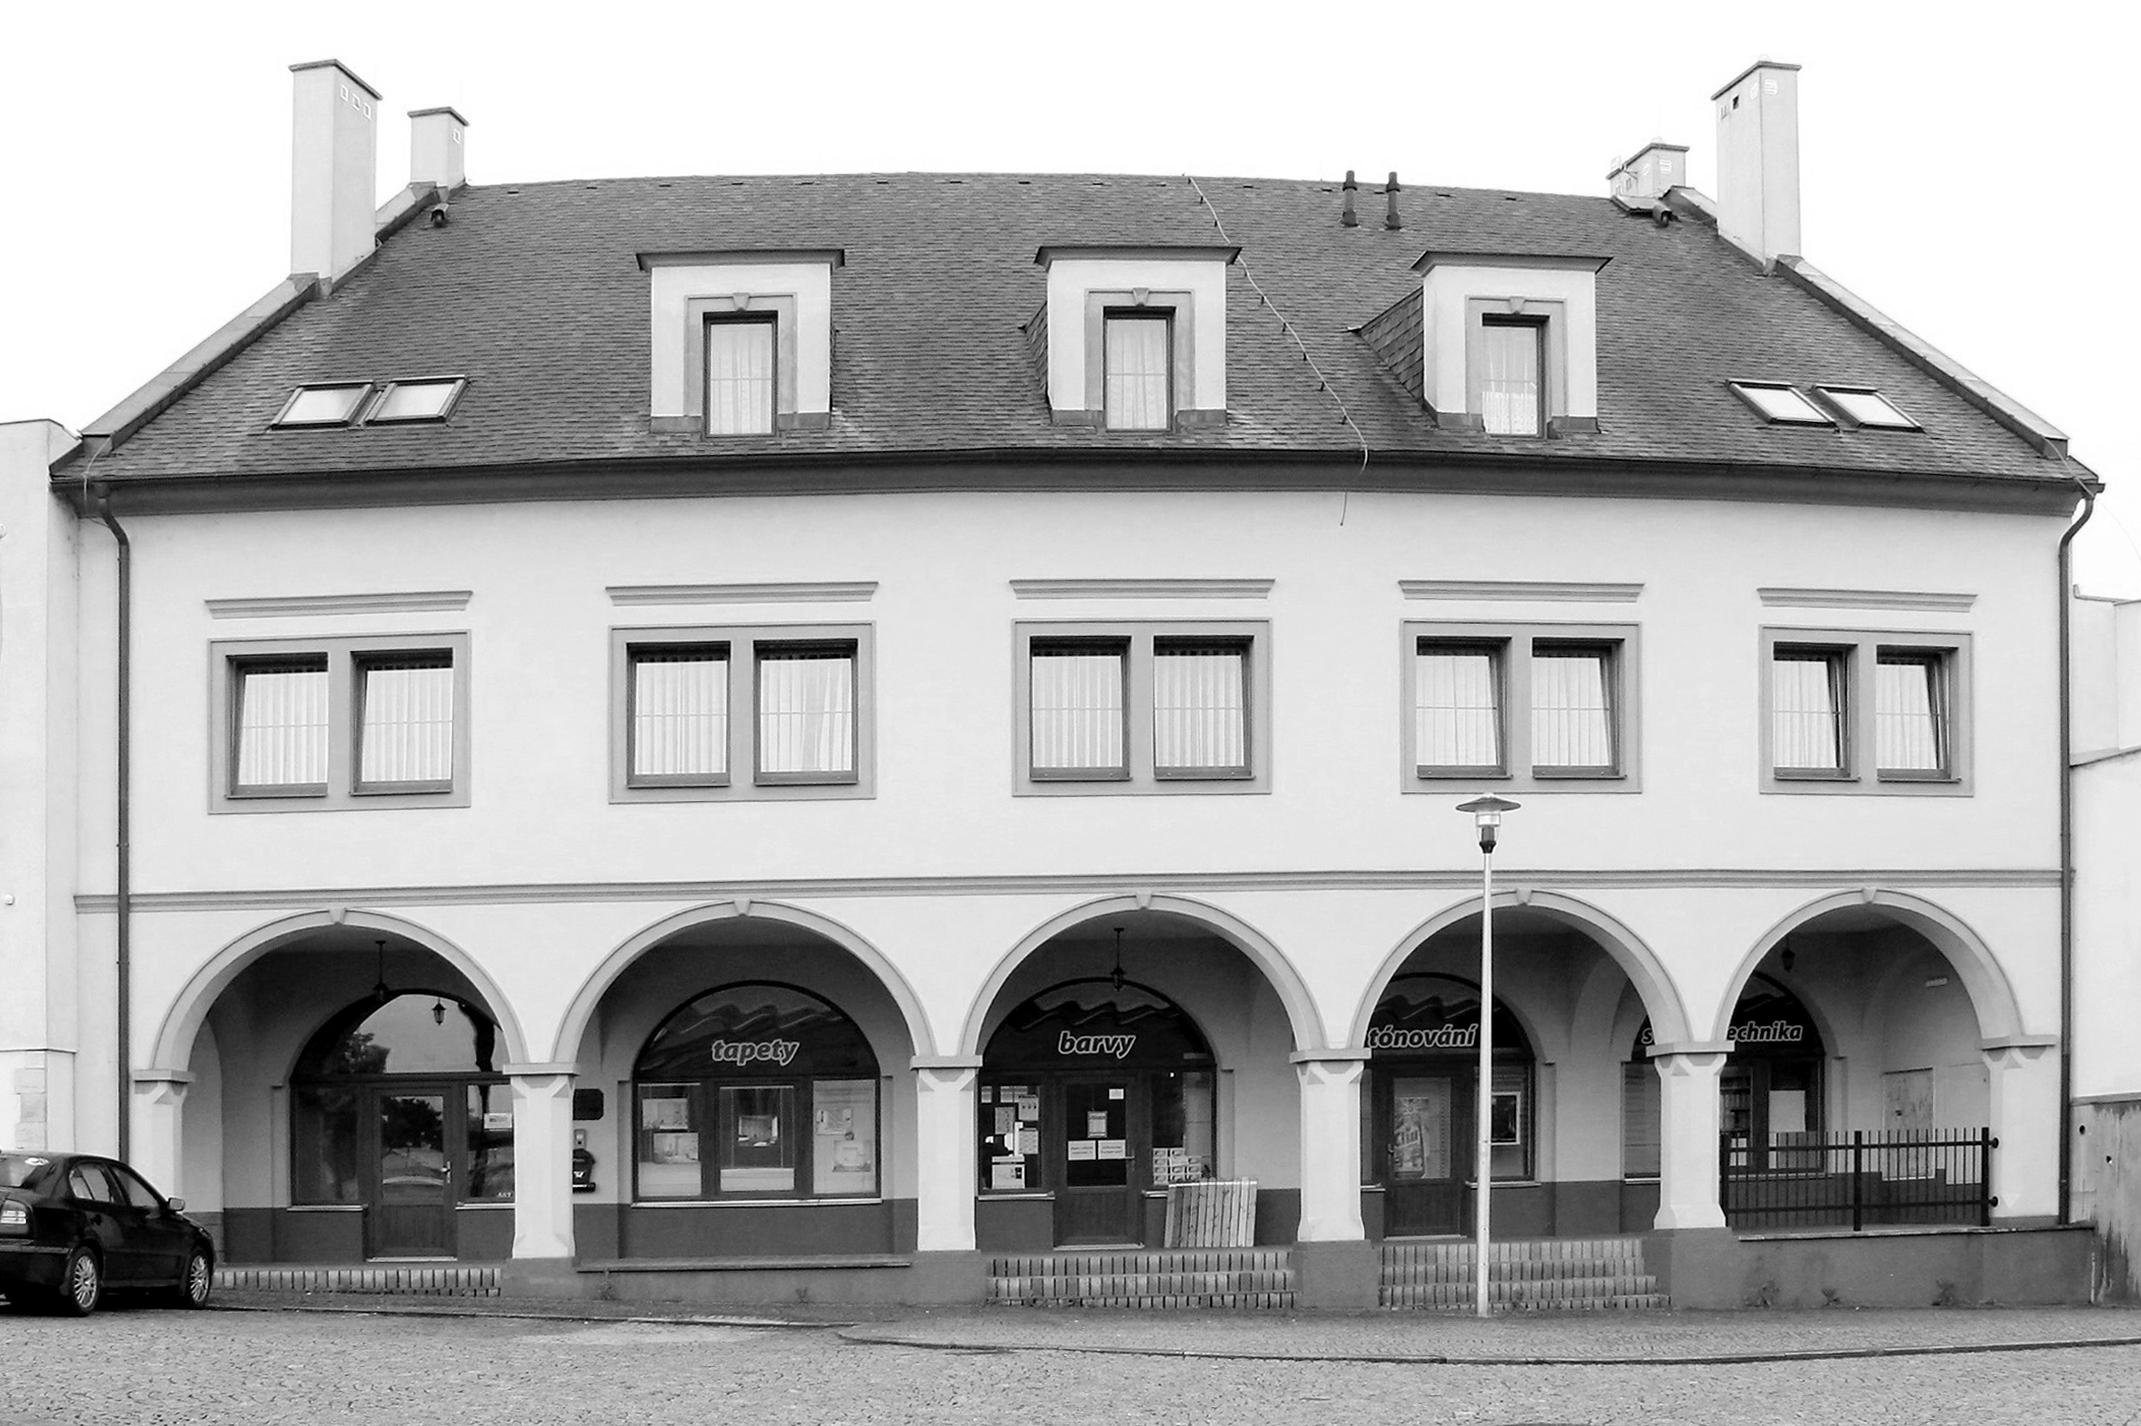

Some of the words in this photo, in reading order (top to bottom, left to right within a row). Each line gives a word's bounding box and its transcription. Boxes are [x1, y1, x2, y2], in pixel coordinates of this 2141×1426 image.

[1368, 1023, 1479, 1048] tónování
[1727, 1020, 1803, 1043] echnika
[711, 1038, 800, 1066] tapety
[1058, 1030, 1137, 1060] barvy
